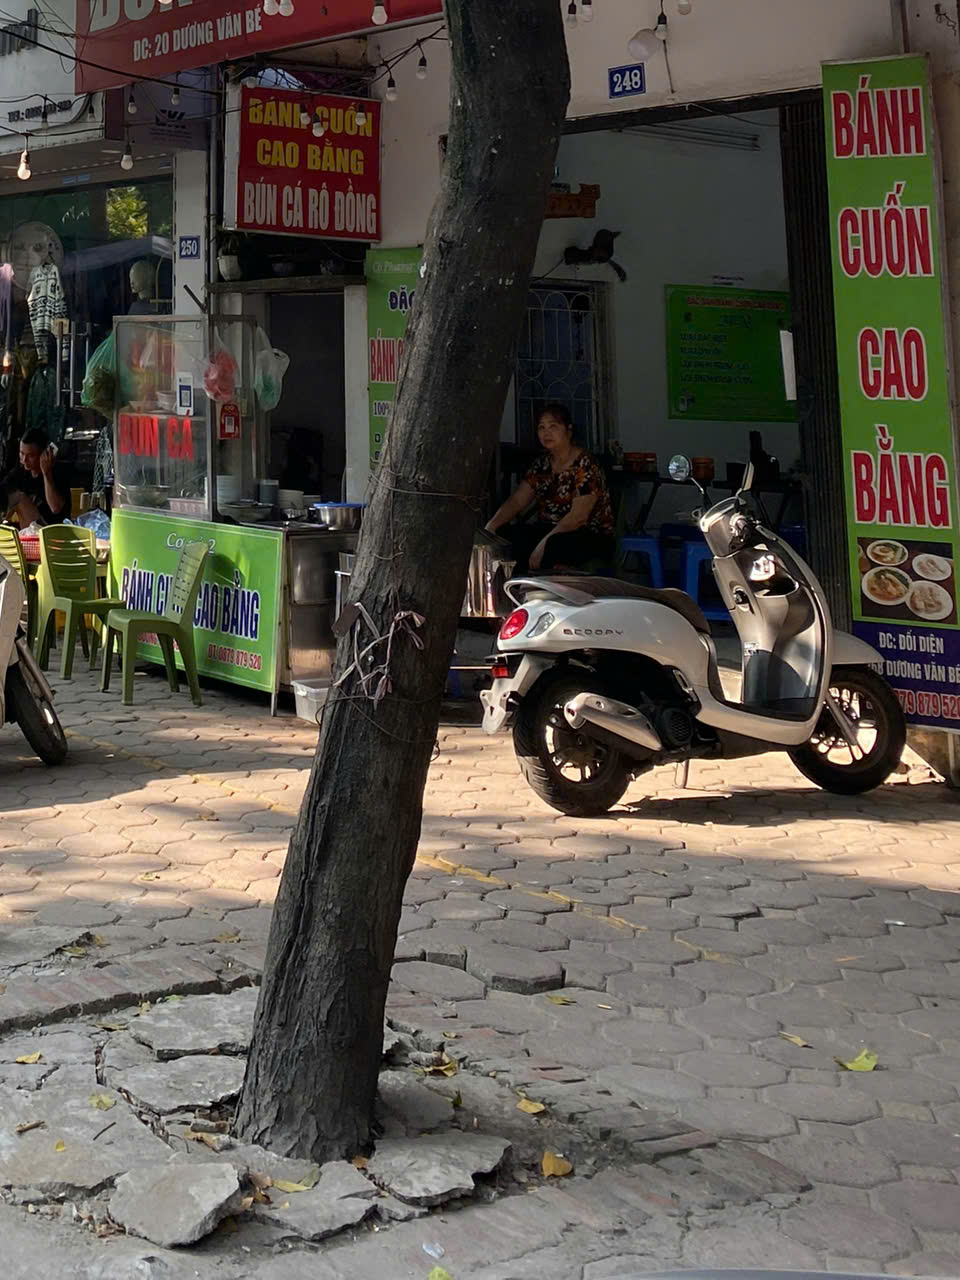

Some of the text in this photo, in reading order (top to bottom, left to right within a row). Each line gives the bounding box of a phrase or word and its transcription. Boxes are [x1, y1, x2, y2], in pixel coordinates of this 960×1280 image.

[154, 35, 170, 56] 20
[172, 23, 214, 52] DƯƠNG
[215, 11, 243, 40] VĂN
[244, 3, 263, 34] BÉ
[613, 70, 642, 93] 248
[315, 102, 373, 137] CUỐN
[831, 74, 927, 158] BÁNH
[256, 138, 365, 176] CAO BẰNG
[243, 176, 377, 235] BÚN CÁ RÔ ĐỒNG
[180, 241, 198, 256] 250
[838, 181, 934, 278] CUỐN
[857, 327, 928, 401] CAO
[851, 424, 954, 529] BẰNG
[221, 567, 261, 641] BẰNG
[918, 633, 945, 657] DIỆN
[885, 659, 922, 681] DƯƠNG
[922, 661, 946, 683] VĂN
[917, 691, 941, 717] 879
